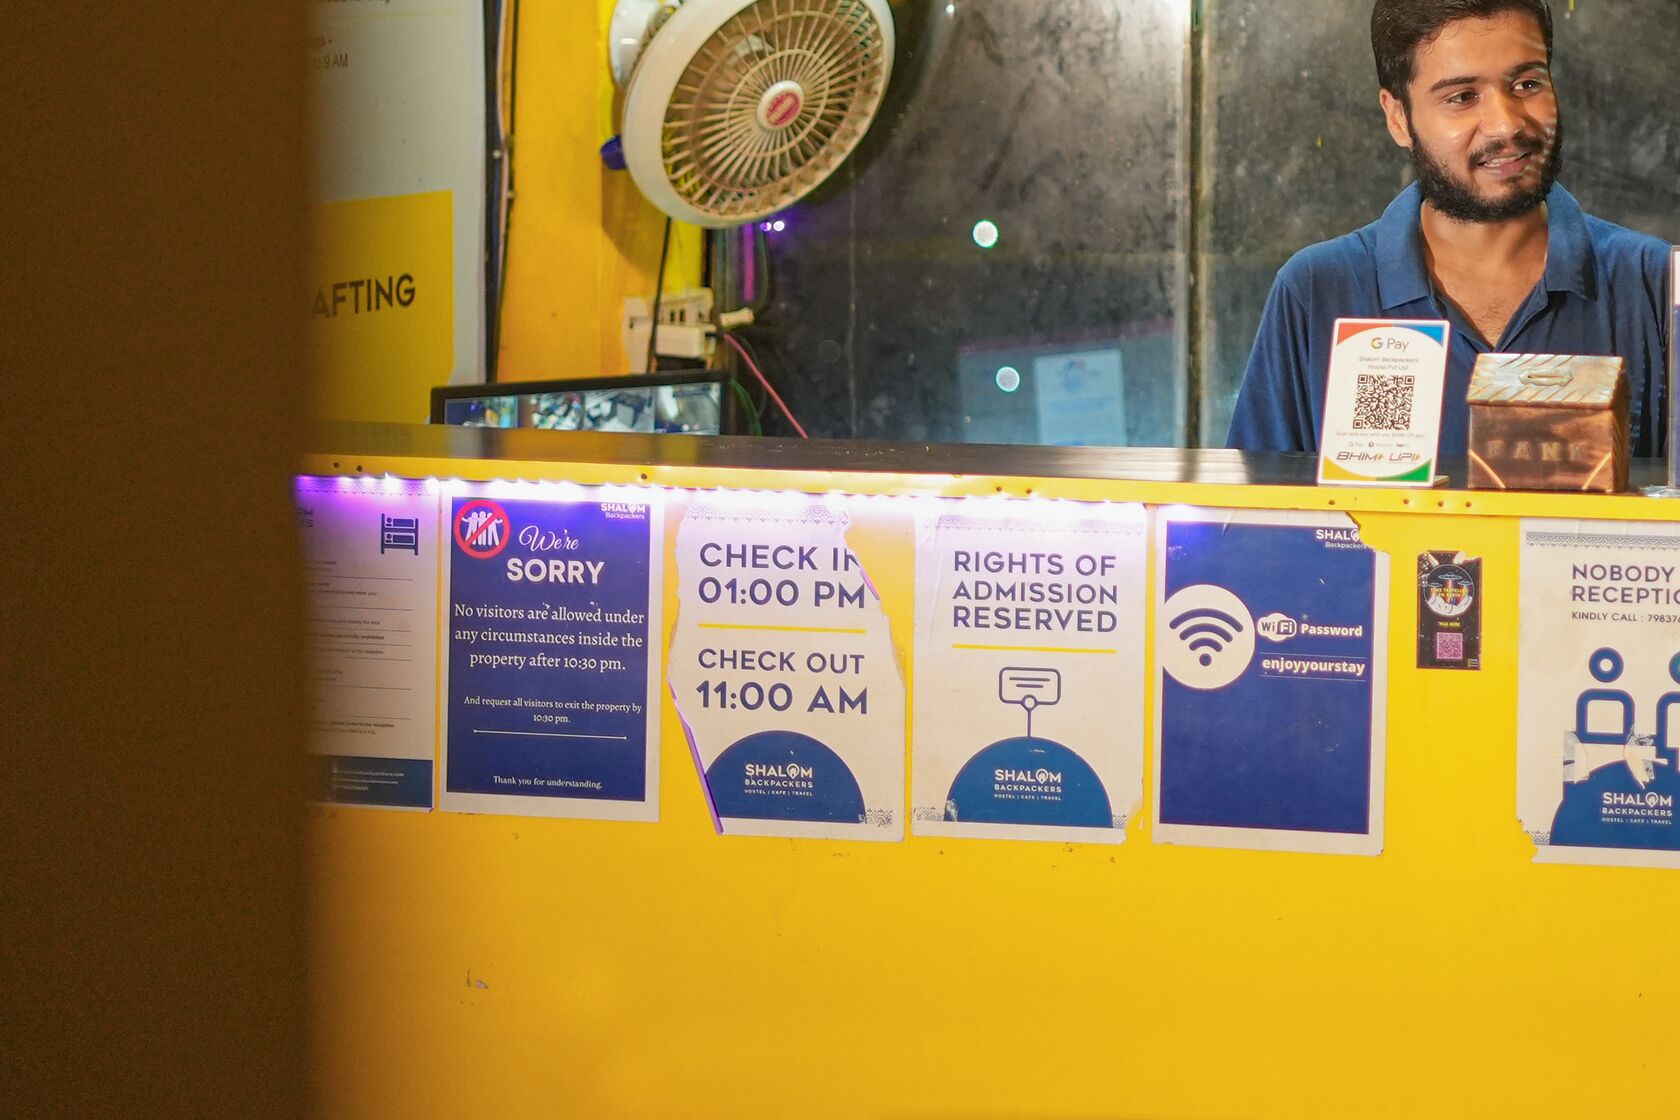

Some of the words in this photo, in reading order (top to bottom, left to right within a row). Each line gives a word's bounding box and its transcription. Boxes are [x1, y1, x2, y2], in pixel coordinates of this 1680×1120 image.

[311, 273, 416, 318] AFTING
[1387, 338, 1409, 352] Pay
[1336, 451, 1377, 461] BHIM
[1389, 452, 1415, 461] UPI
[605, 512, 645, 520] Backpackers
[519, 525, 579, 552] We're
[700, 542, 818, 571] CHECK
[832, 547, 861, 572] IN
[954, 550, 1064, 575] RIGHTS
[1075, 554, 1116, 577] OF
[507, 557, 605, 585] SORRY
[1572, 563, 1675, 583] NOBODY
[698, 576, 799, 607] 01:00
[814, 581, 865, 609] PM
[952, 580, 1118, 605] ADMISSION
[454, 604, 473, 617] No
[476, 604, 524, 619] visitors
[528, 606, 549, 620] are
[551, 607, 602, 623] allowed
[605, 610, 644, 624] under
[953, 605, 1118, 633] RESERVED
[1572, 611, 1608, 621] KINDLY
[1611, 613, 1637, 622] CALL
[455, 629, 478, 644] any
[481, 628, 575, 644] circumstances
[578, 631, 618, 647] inside
[622, 633, 643, 648] the
[1301, 623, 1363, 637] Password
[470, 653, 526, 670] property
[529, 652, 560, 668] after
[563, 657, 597, 670] 10:30
[600, 658, 626, 673] pm.
[698, 648, 796, 672] CHECK
[806, 652, 865, 675] OUT
[1262, 657, 1365, 676] enjoyyourstay
[464, 696, 481, 705] And
[482, 698, 511, 708] request
[513, 698, 522, 707] all
[524, 699, 553, 708] visitors
[555, 700, 563, 709] to
[564, 700, 579, 710] exit
[581, 701, 594, 710] the
[596, 702, 630, 714] property
[632, 702, 642, 714] by
[696, 680, 793, 712] 11:00
[807, 685, 867, 715] AM
[533, 714, 553, 723] 10:30
[555, 715, 571, 725] pm.
[745, 763, 813, 779] SHALOM
[994, 768, 1062, 785] SHALOM
[493, 775, 516, 785] Thank
[518, 777, 532, 787] you
[533, 777, 545, 786] for
[744, 779, 813, 788] BACKPACKERS
[994, 784, 1062, 793] BACKPACKERS
[1602, 792, 1672, 807] SHALOM
[1602, 807, 1672, 817] BACKPACKERS
